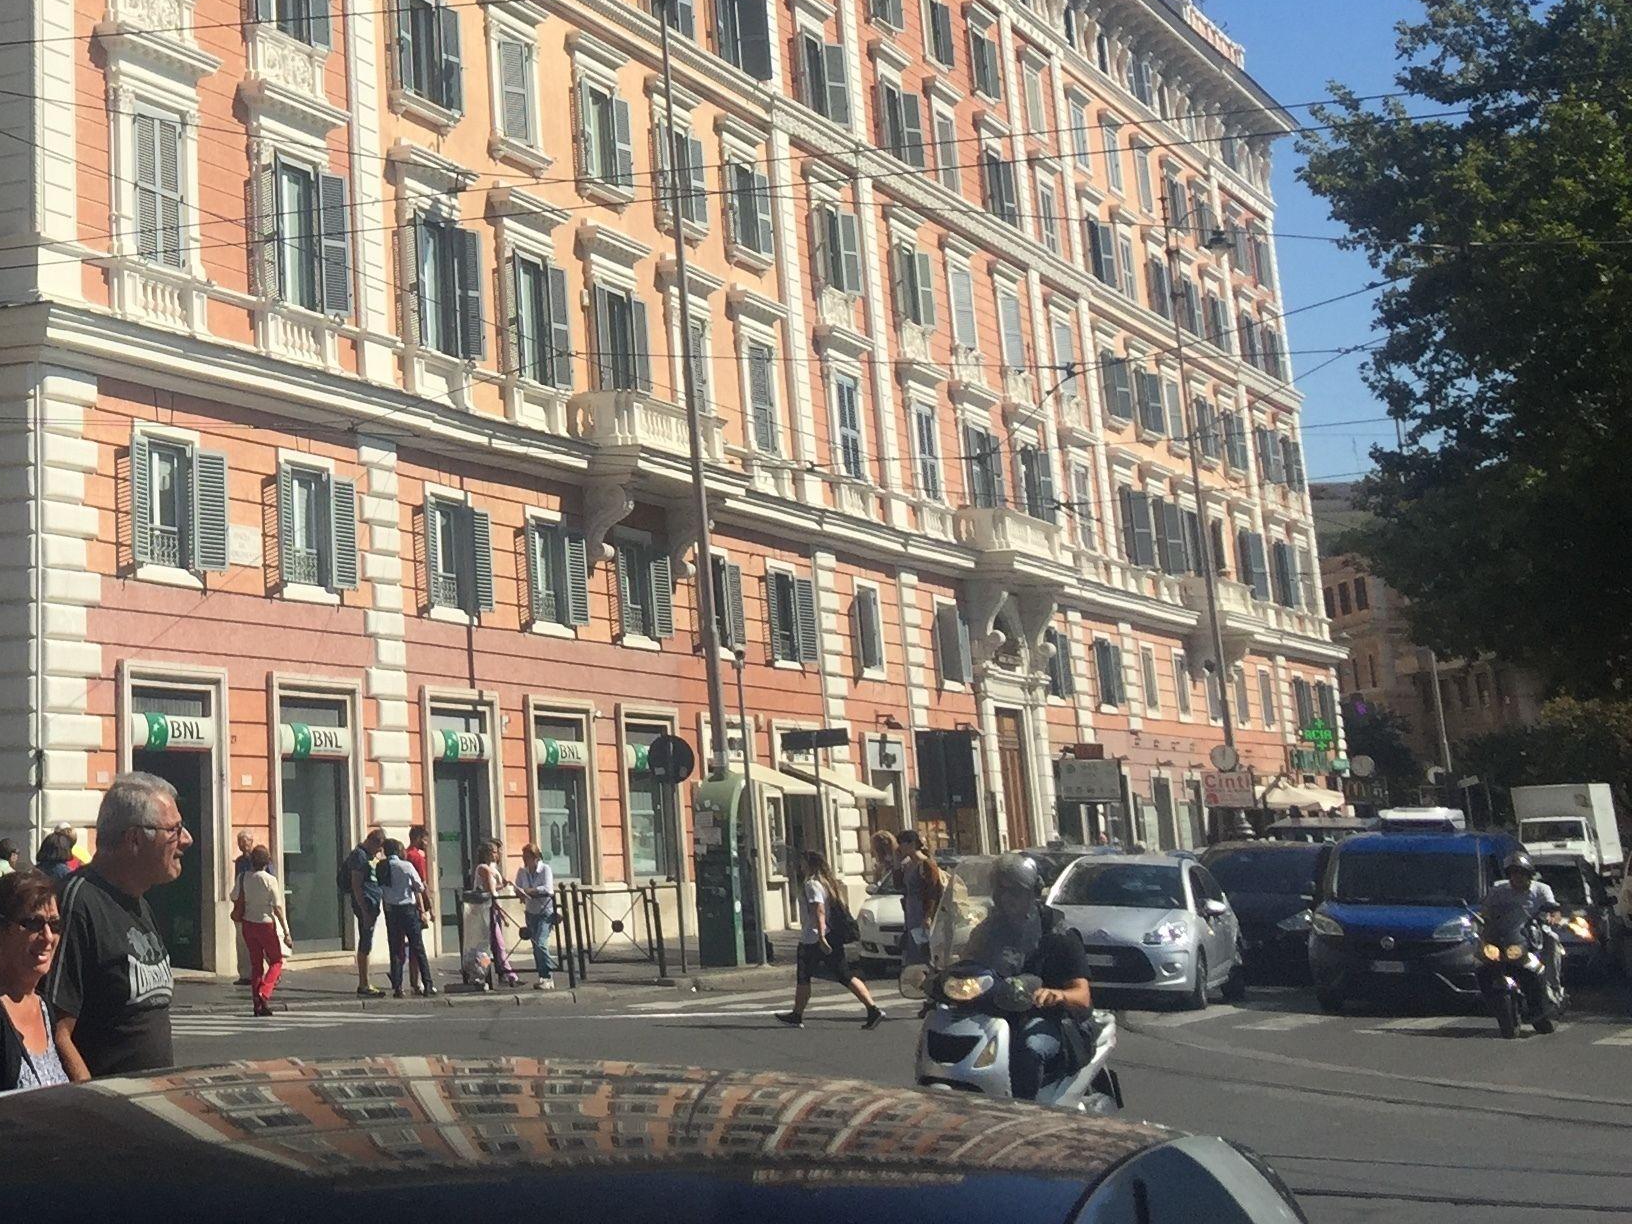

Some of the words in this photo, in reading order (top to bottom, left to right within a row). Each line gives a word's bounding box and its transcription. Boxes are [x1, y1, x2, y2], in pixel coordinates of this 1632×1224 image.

[170, 720, 205, 740] BNL
[312, 730, 343, 749] BNL
[559, 744, 582, 760] BNL
[1204, 774, 1250, 788] Cinti
